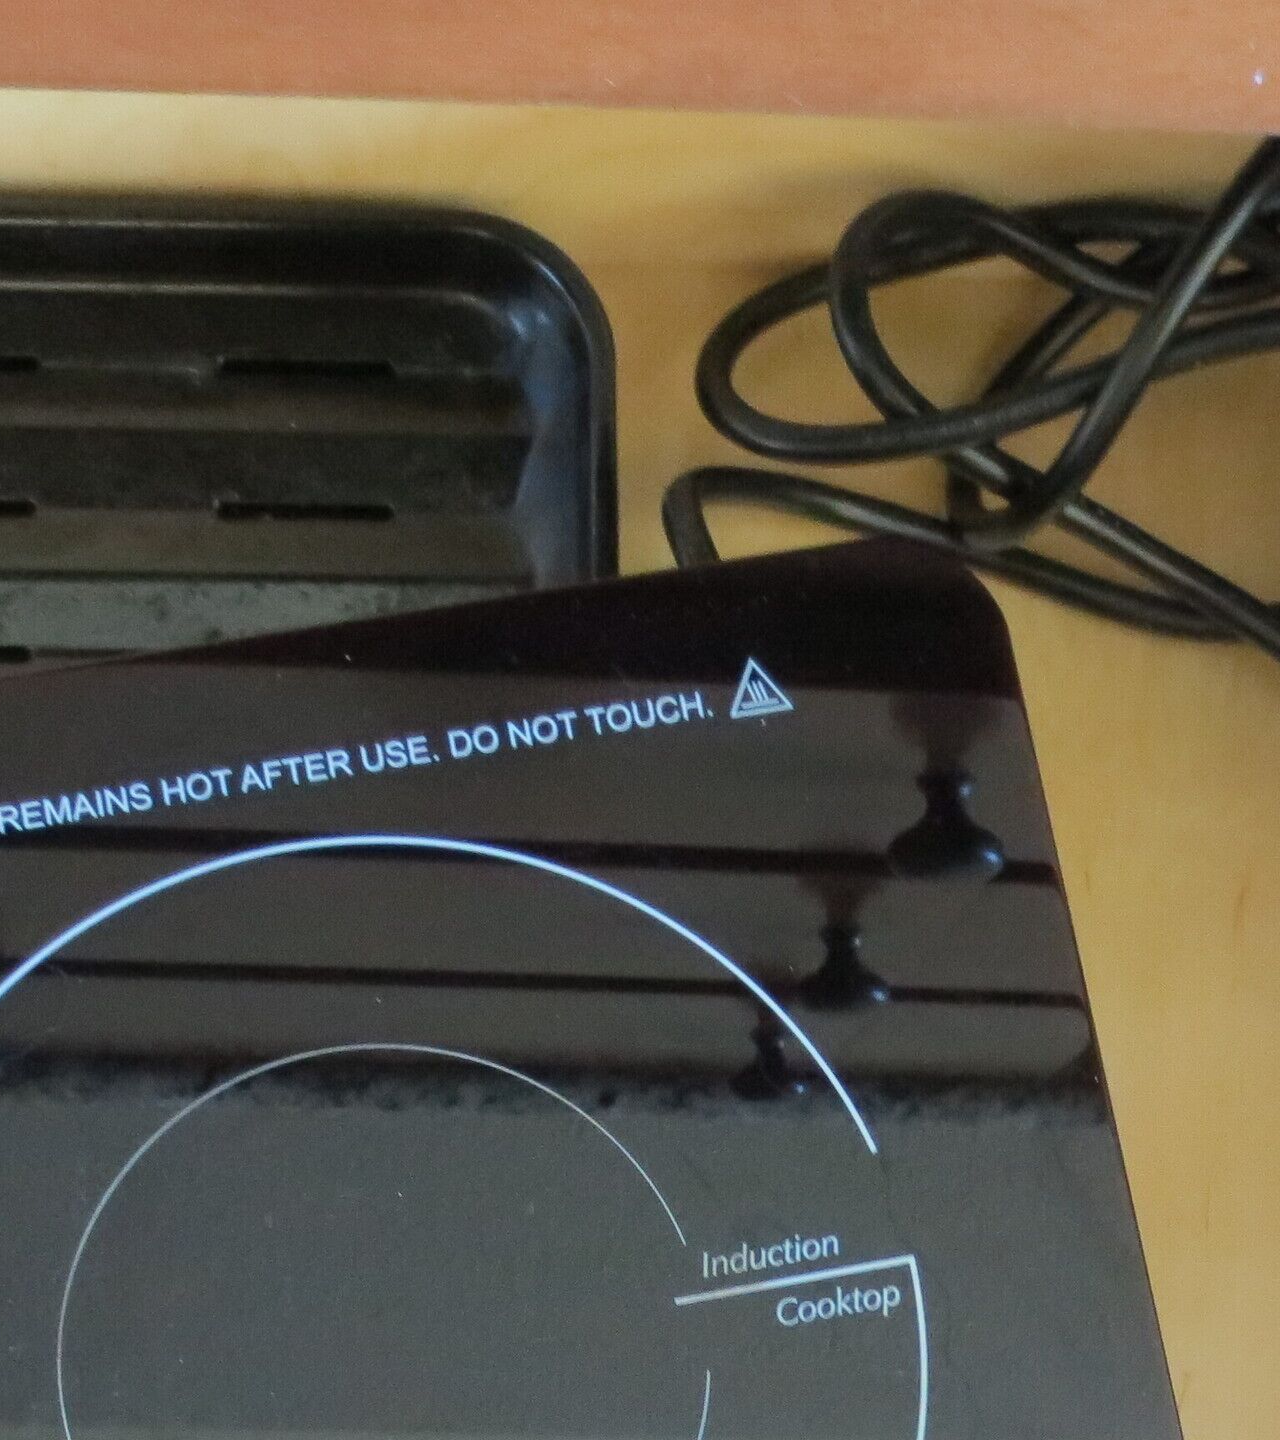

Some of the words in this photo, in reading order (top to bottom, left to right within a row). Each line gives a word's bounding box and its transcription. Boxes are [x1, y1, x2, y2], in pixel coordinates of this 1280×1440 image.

[161, 767, 232, 808] HOT
[240, 748, 352, 795] AFTER
[360, 735, 440, 775] USE.
[447, 722, 500, 759] DO
[506, 710, 578, 749] NOT
[585, 690, 714, 736] TOUCH.
[702, 1233, 840, 1279] Induction
[776, 1284, 902, 1328] Cooktop
